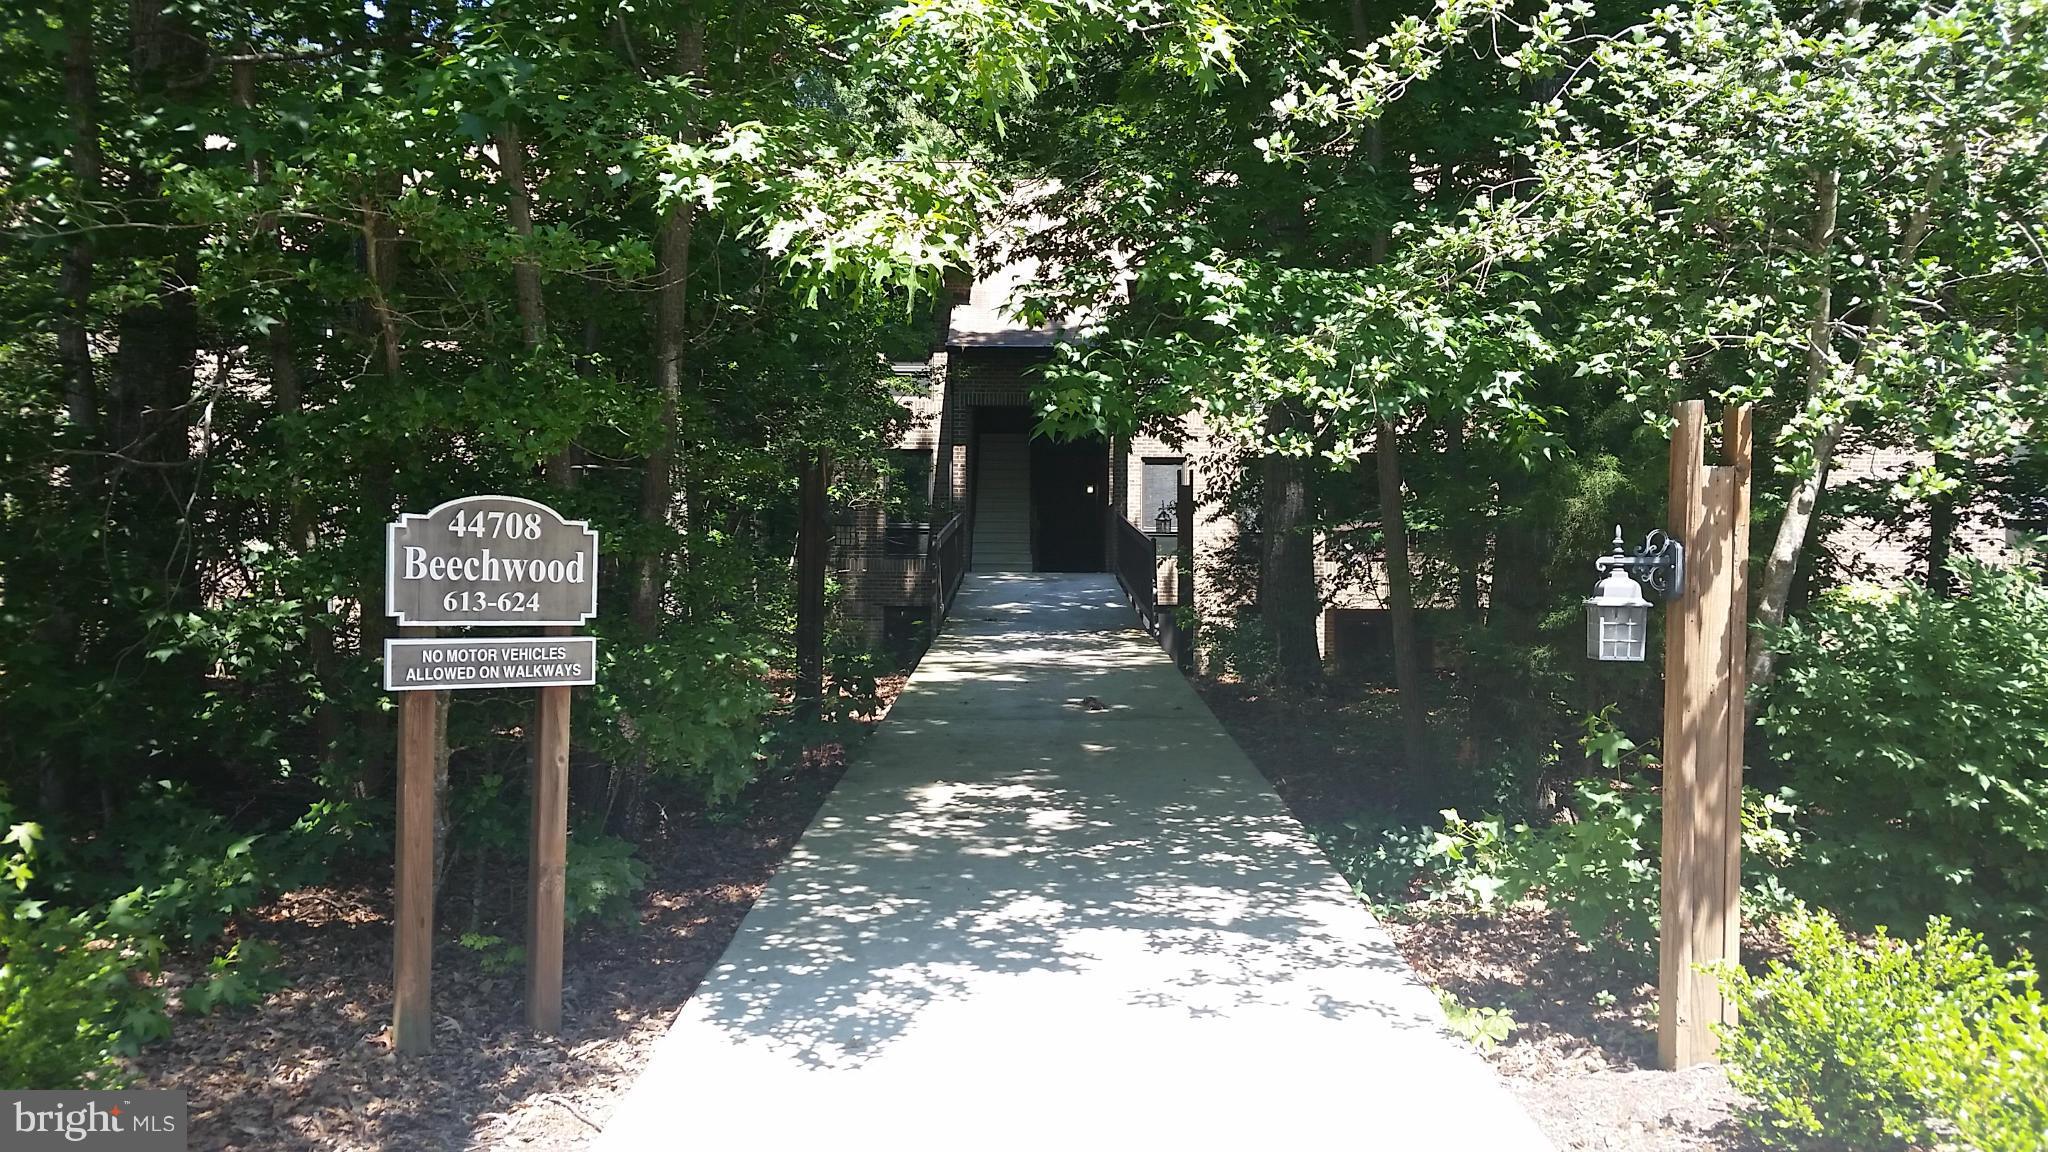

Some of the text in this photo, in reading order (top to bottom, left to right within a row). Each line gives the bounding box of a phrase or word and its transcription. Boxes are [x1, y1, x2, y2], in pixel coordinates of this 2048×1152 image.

[449, 509, 542, 540] 44708
[402, 546, 585, 584] Beechwood
[443, 591, 540, 612] 613-624
[422, 647, 567, 663] NO MOTOR VEHICLES
[405, 664, 582, 682] ALLOWED ON WALKWAYS
